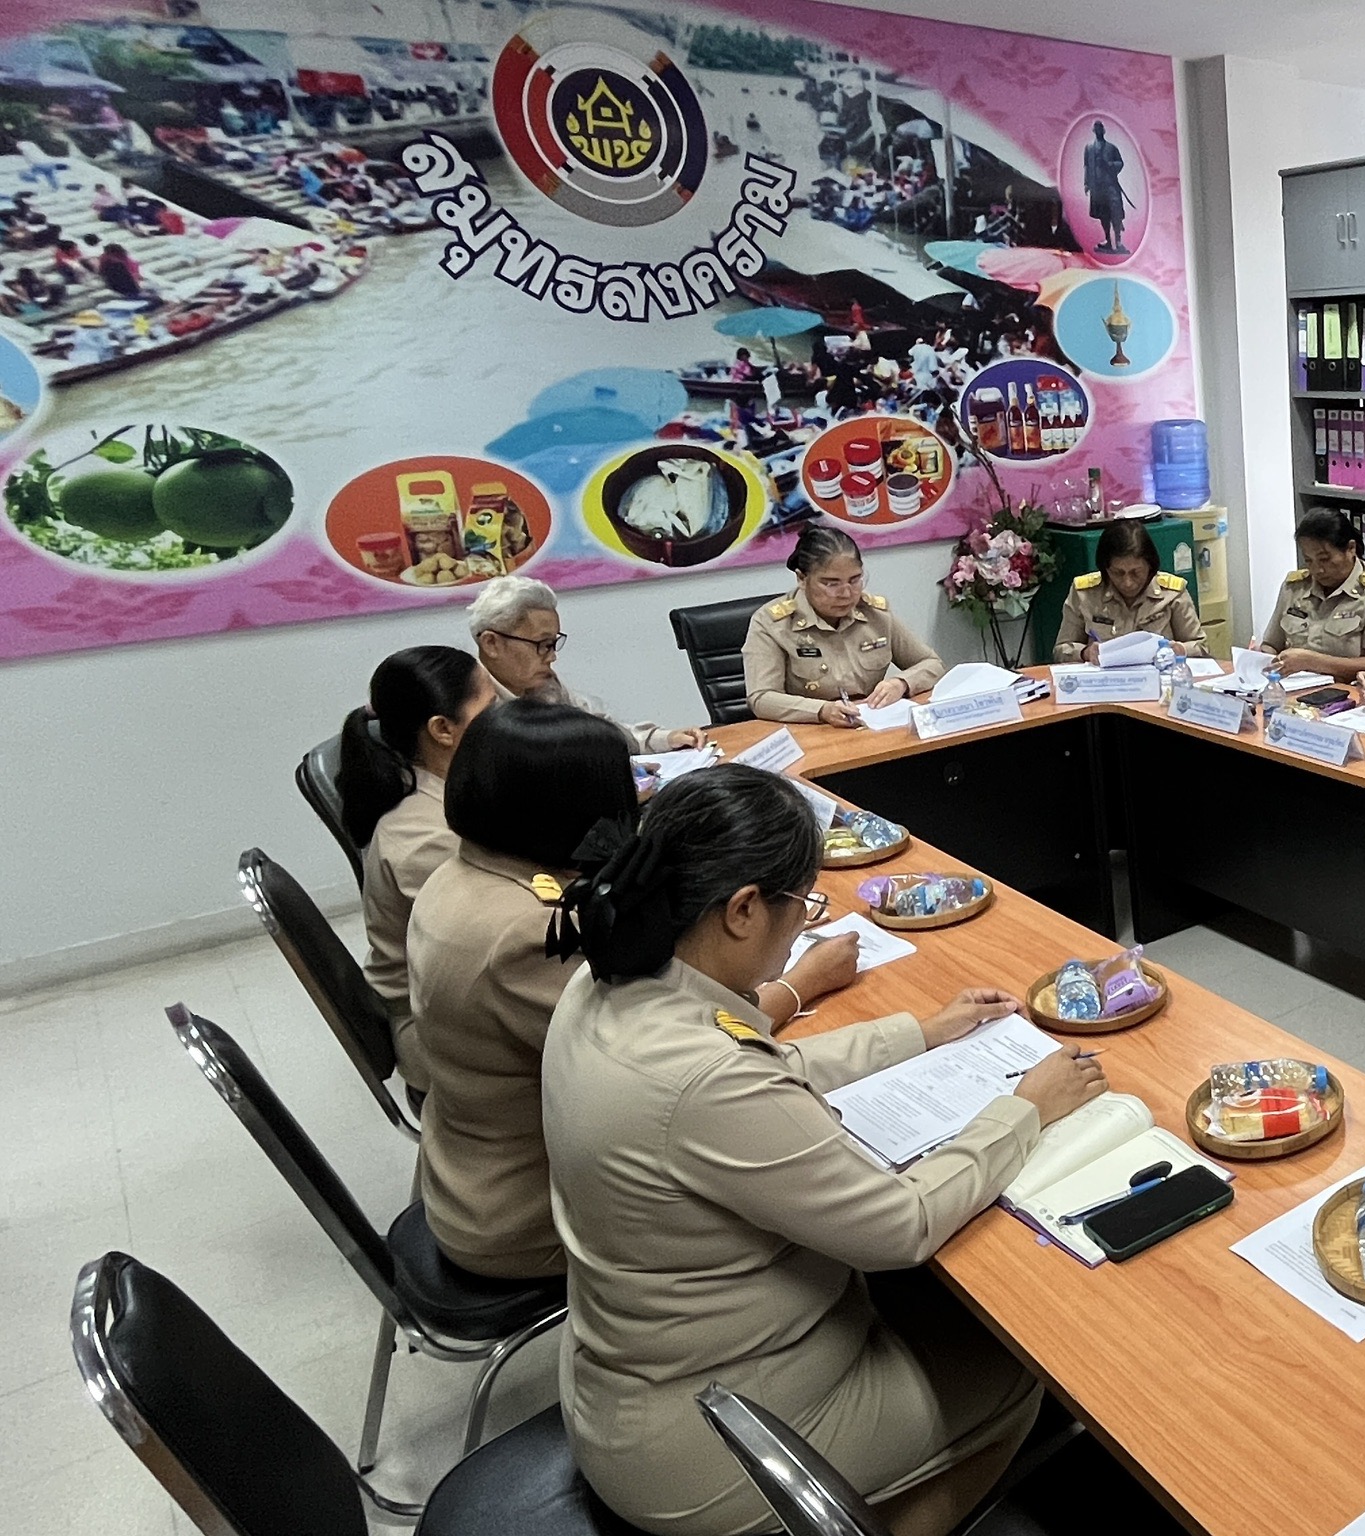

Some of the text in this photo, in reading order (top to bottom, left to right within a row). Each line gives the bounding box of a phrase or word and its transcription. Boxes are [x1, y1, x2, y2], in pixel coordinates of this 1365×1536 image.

[401, 129, 797, 323] สมุทรสงคราม
